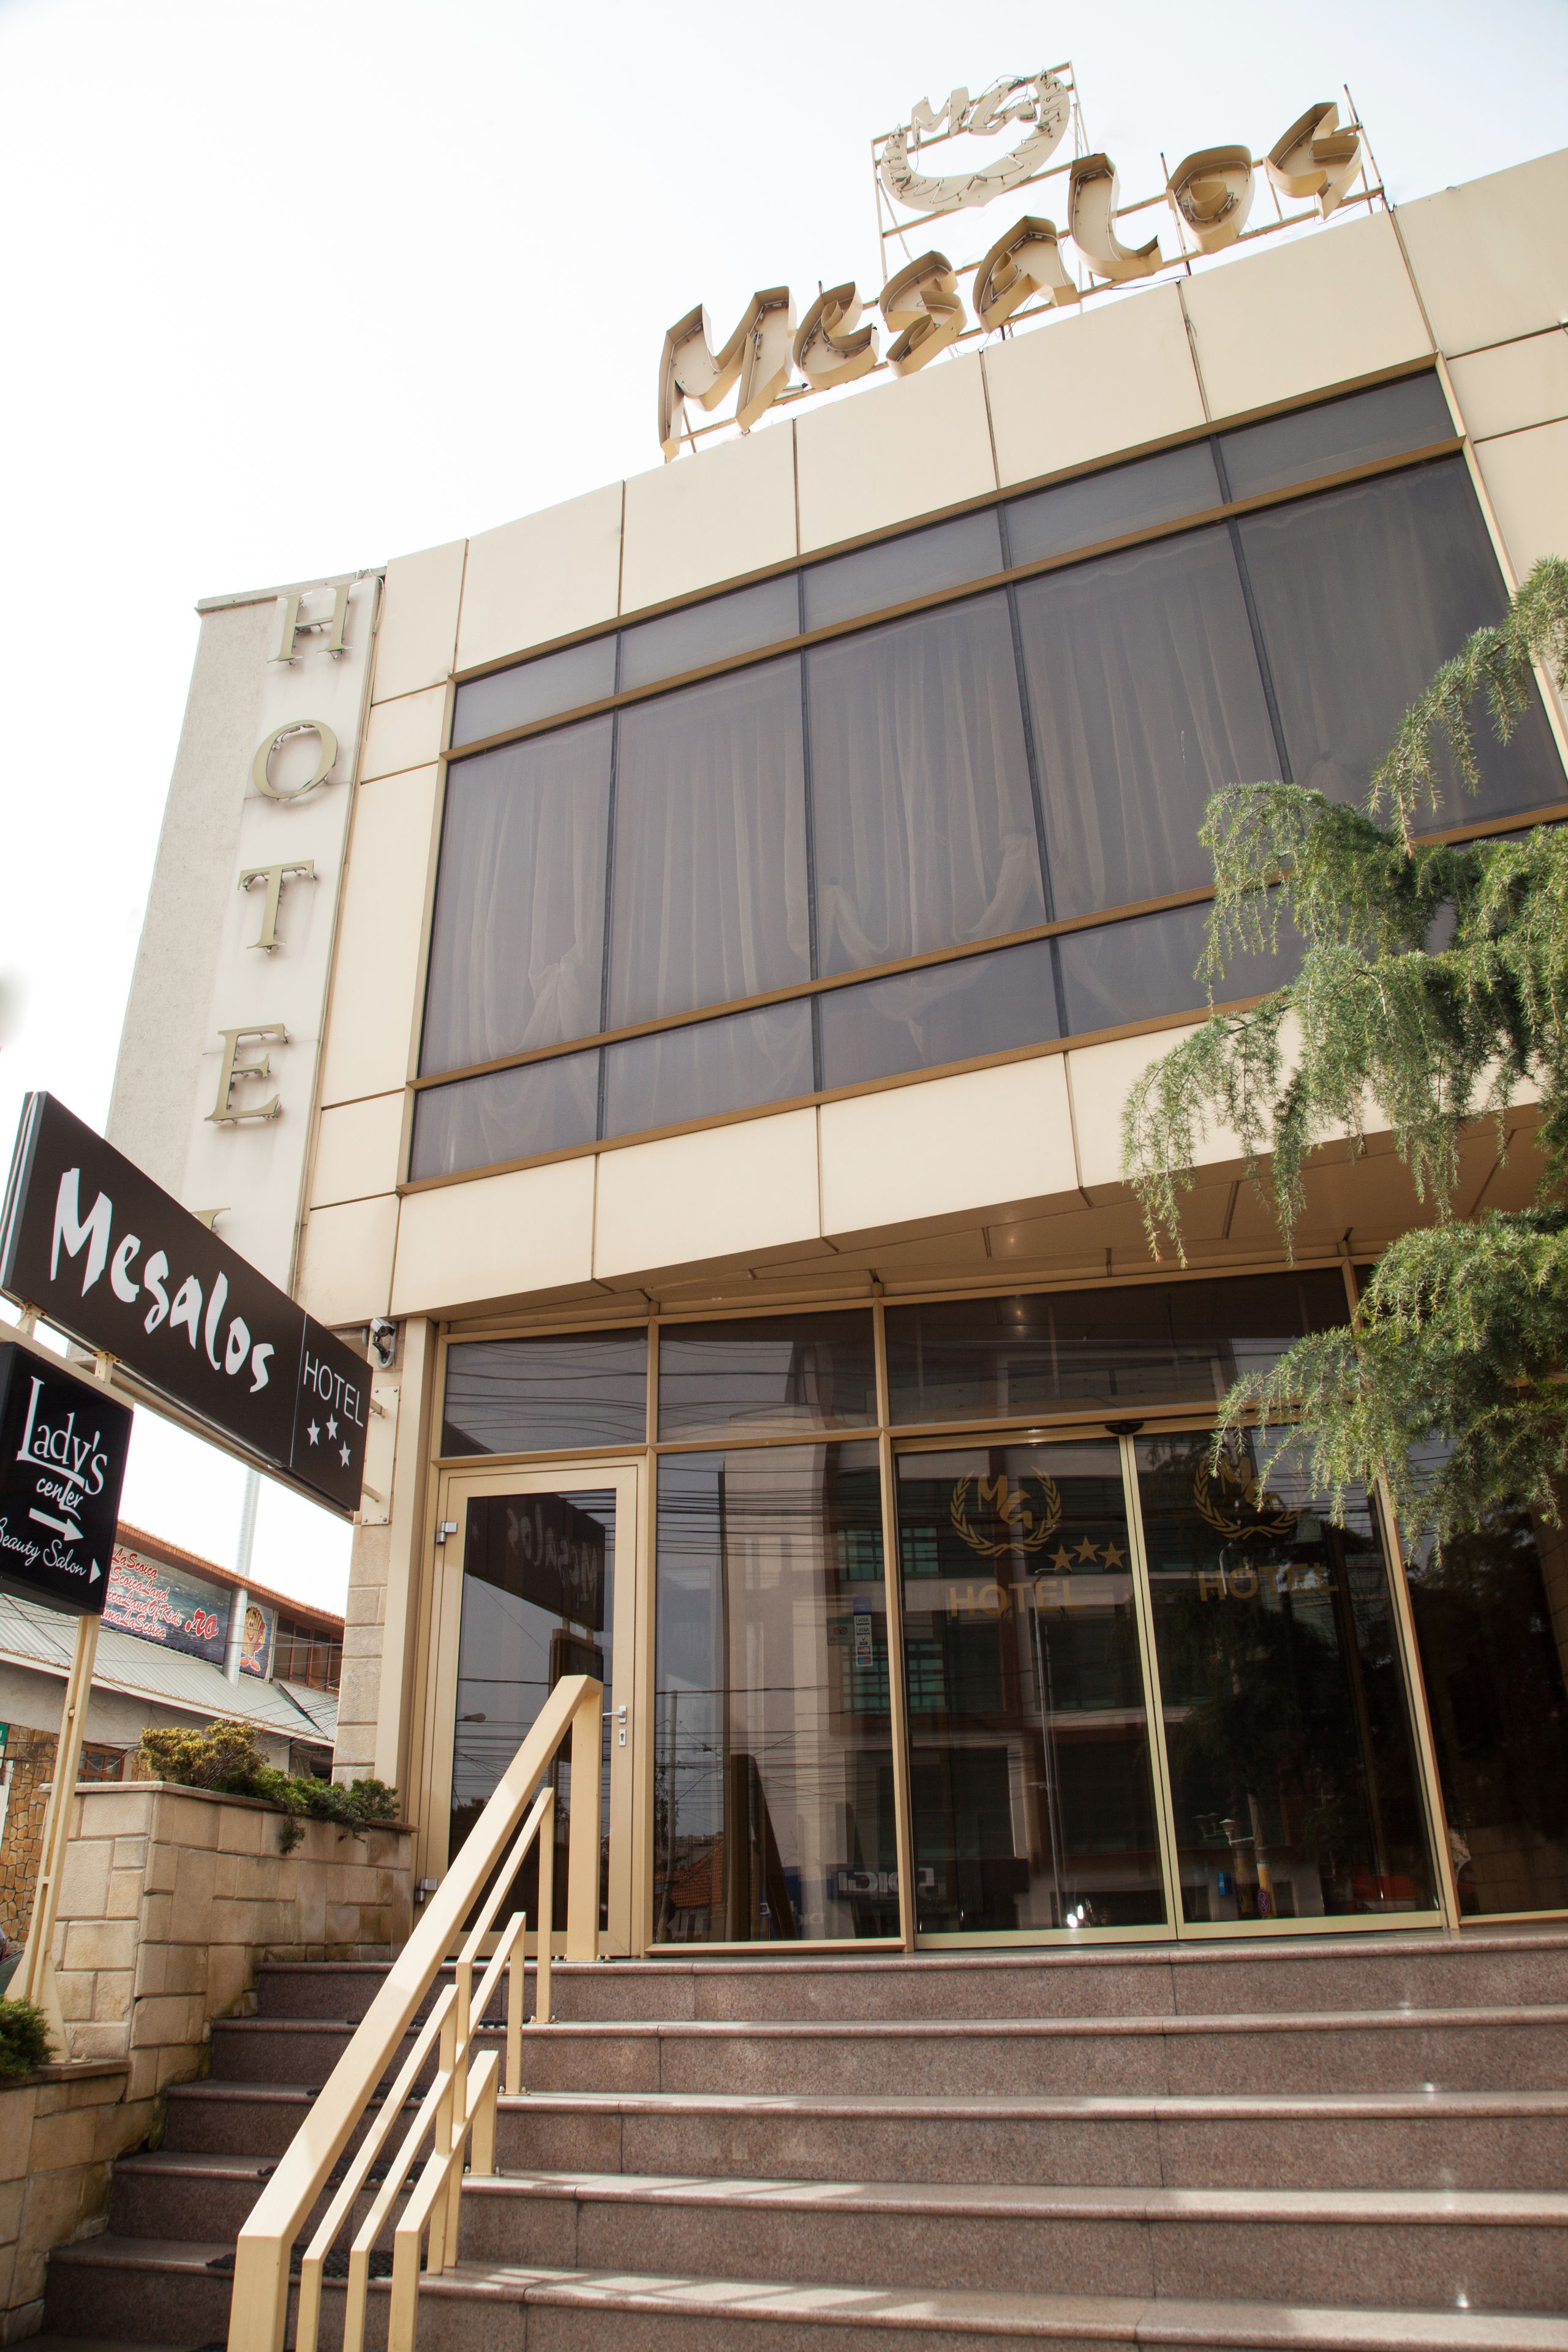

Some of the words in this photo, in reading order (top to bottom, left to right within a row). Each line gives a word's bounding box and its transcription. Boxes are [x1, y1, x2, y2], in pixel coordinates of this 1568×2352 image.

[190, 579, 363, 1231] HOTE
[303, 1351, 364, 1428] HOTEL
[16, 1376, 108, 1495] Lady's
[43, 1540, 87, 1576] Salon
[108, 1566, 170, 1602] ScoicaLand
[950, 1580, 1086, 1617] HOTEL
[1198, 1562, 1339, 1601] HOTEL
